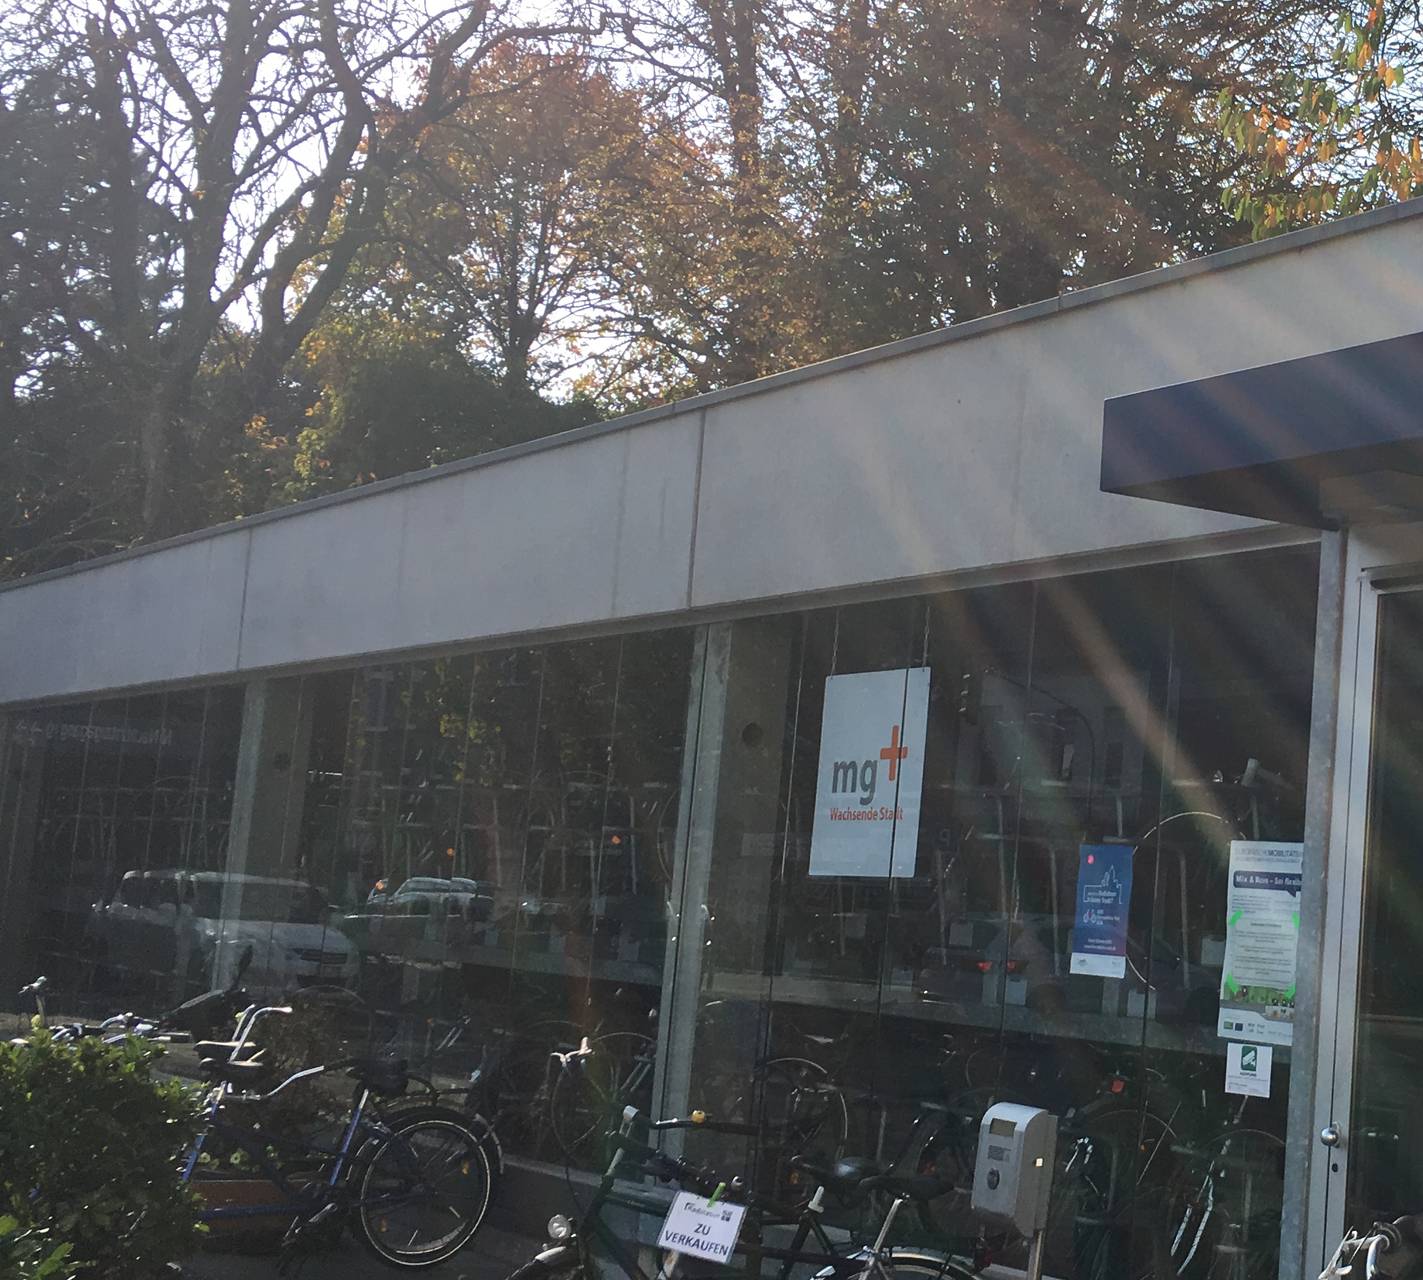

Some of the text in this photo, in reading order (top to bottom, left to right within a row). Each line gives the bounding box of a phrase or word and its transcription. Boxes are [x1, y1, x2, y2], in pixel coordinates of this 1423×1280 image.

[830, 806, 878, 821] Wachsende
[694, 1223, 711, 1236] ZU
[665, 1230, 729, 1256] VERKAUFEN
